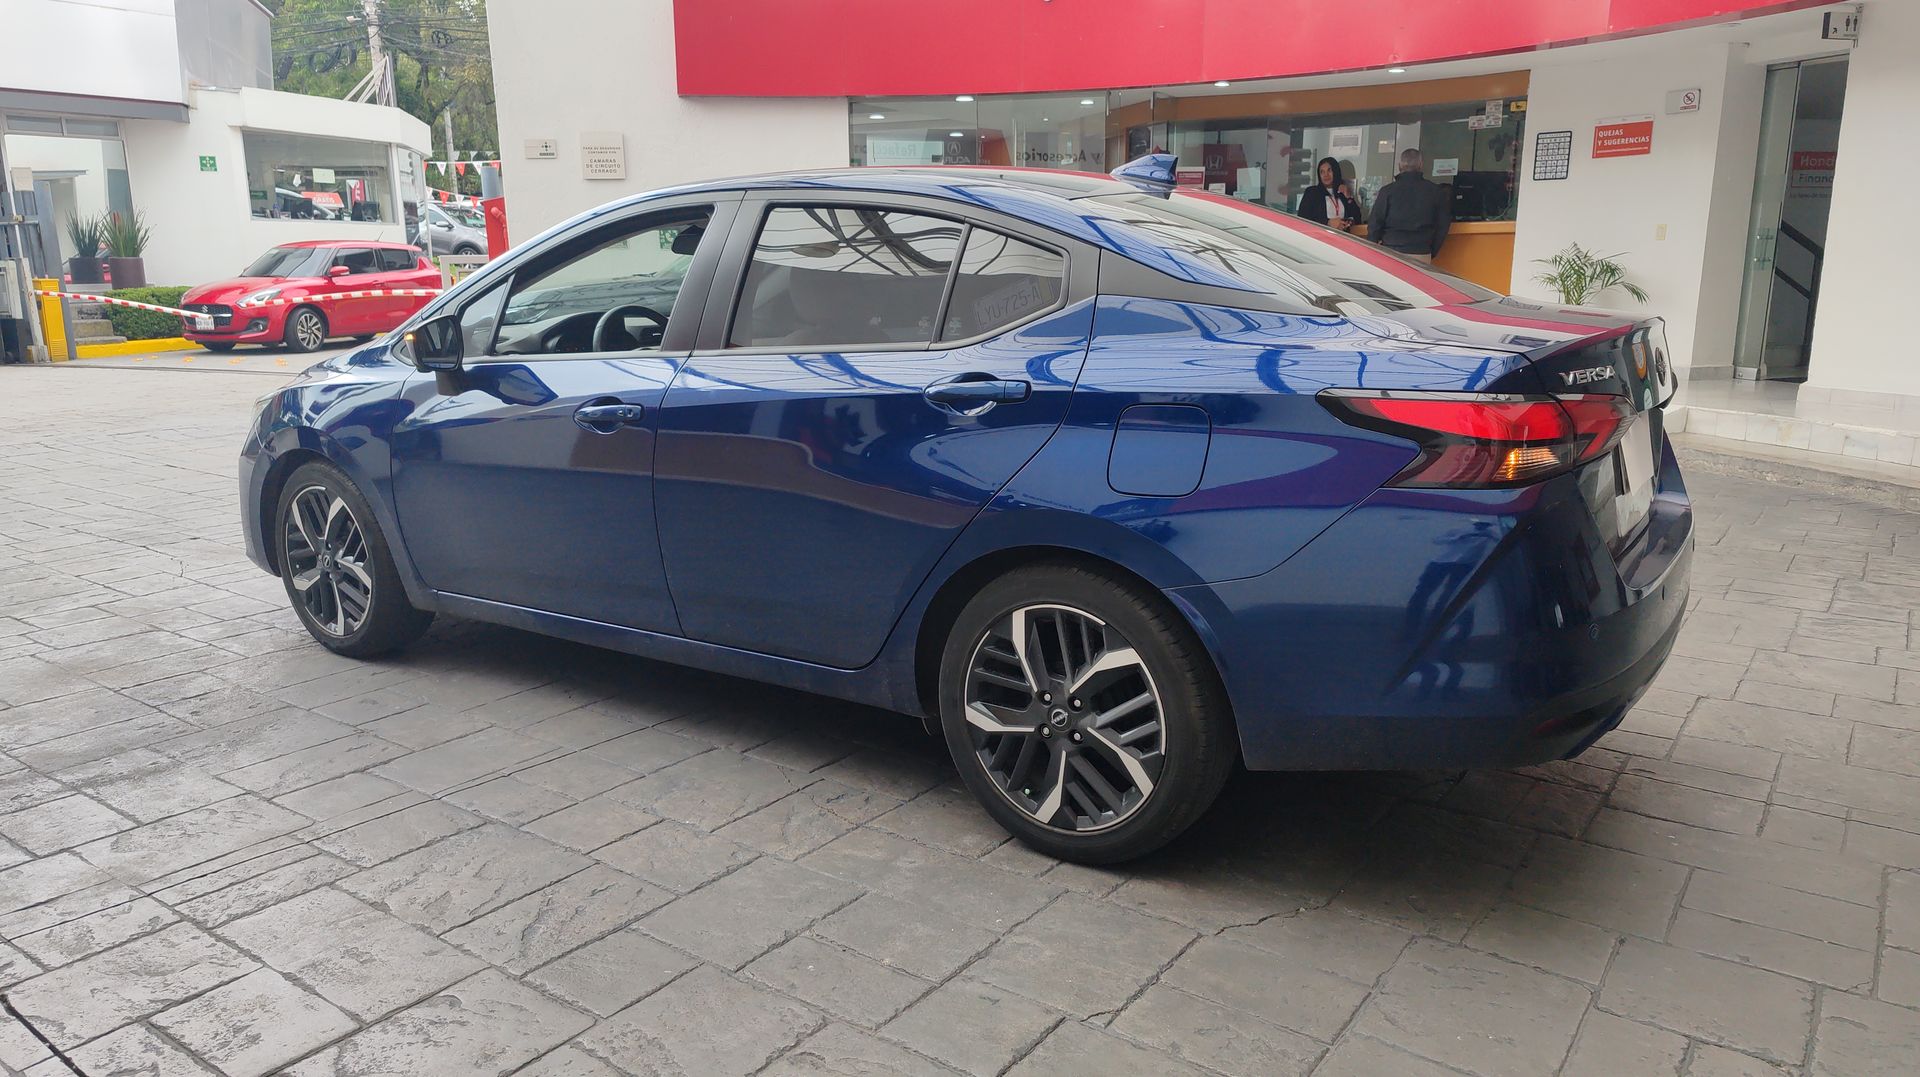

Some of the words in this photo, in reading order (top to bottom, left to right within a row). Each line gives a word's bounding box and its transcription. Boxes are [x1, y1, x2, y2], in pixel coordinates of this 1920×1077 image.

[1599, 129, 1623, 138] QUEJAS
[1604, 136, 1650, 146] SUGERENCIAS
[1559, 366, 1615, 385] VERSA
